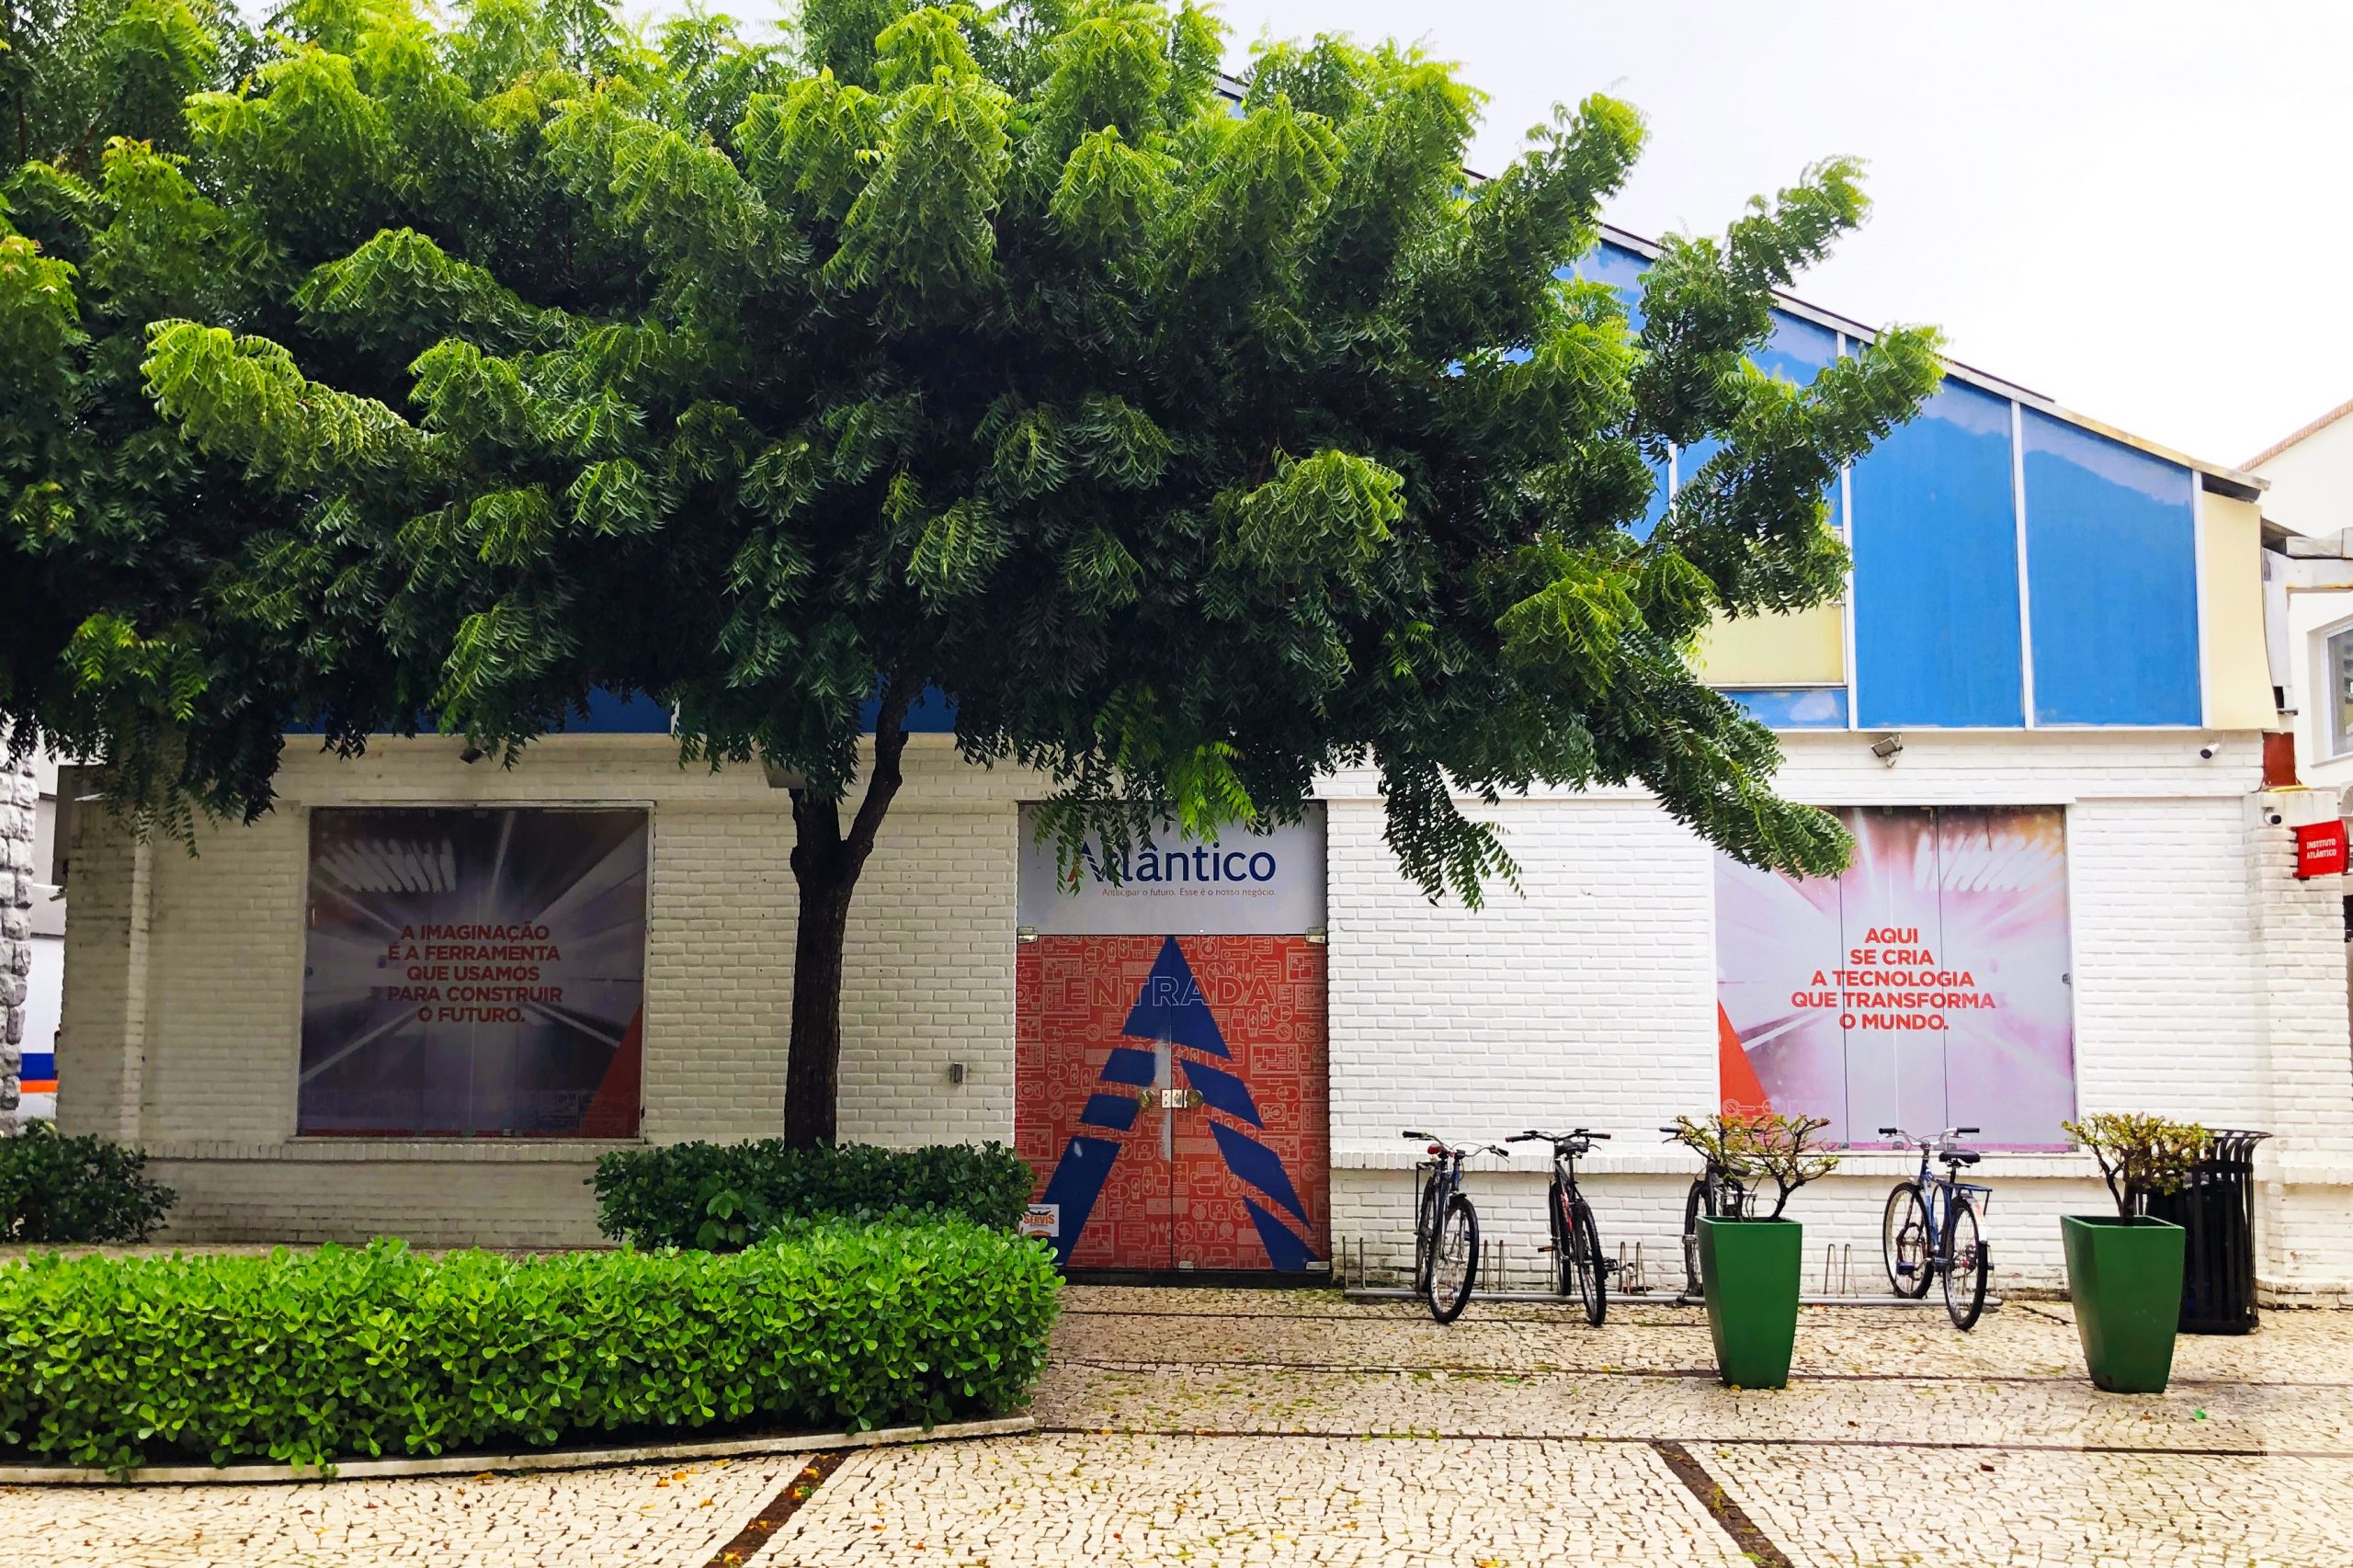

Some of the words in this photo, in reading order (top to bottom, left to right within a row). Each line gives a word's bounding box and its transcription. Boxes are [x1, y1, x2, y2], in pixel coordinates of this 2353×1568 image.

[2306, 838, 2336, 849] INSTITUTO
[1102, 888, 1141, 897] Antecipar
[1179, 888, 1198, 896] Esse
[401, 925, 414, 940] A
[421, 921, 550, 943] IMAGINAÇÃO
[1864, 927, 1918, 943] AQUI
[388, 942, 401, 960] É
[404, 946, 419, 960] A
[425, 946, 561, 960] FERRAMENTA
[1850, 949, 1877, 965] SE
[1881, 949, 1935, 965] CRIA
[406, 966, 449, 981] QUE
[454, 966, 540, 981] USAMOS
[1811, 971, 1827, 986] A
[1832, 971, 1975, 986] TECNOLOGIA
[388, 986, 441, 1002] PARA
[447, 986, 563, 1002] CONSTRUIR
[1063, 976, 1278, 1006] ENTRADA
[1791, 991, 1837, 1008] QUE
[1843, 992, 1996, 1009] TRANSFORMA
[417, 1006, 433, 1022] O
[438, 1007, 526, 1022] FUTURO.
[1839, 1014, 1856, 1029] O
[1861, 1014, 1949, 1030] MUNDO.
[1024, 1214, 1054, 1224] SERVIS
